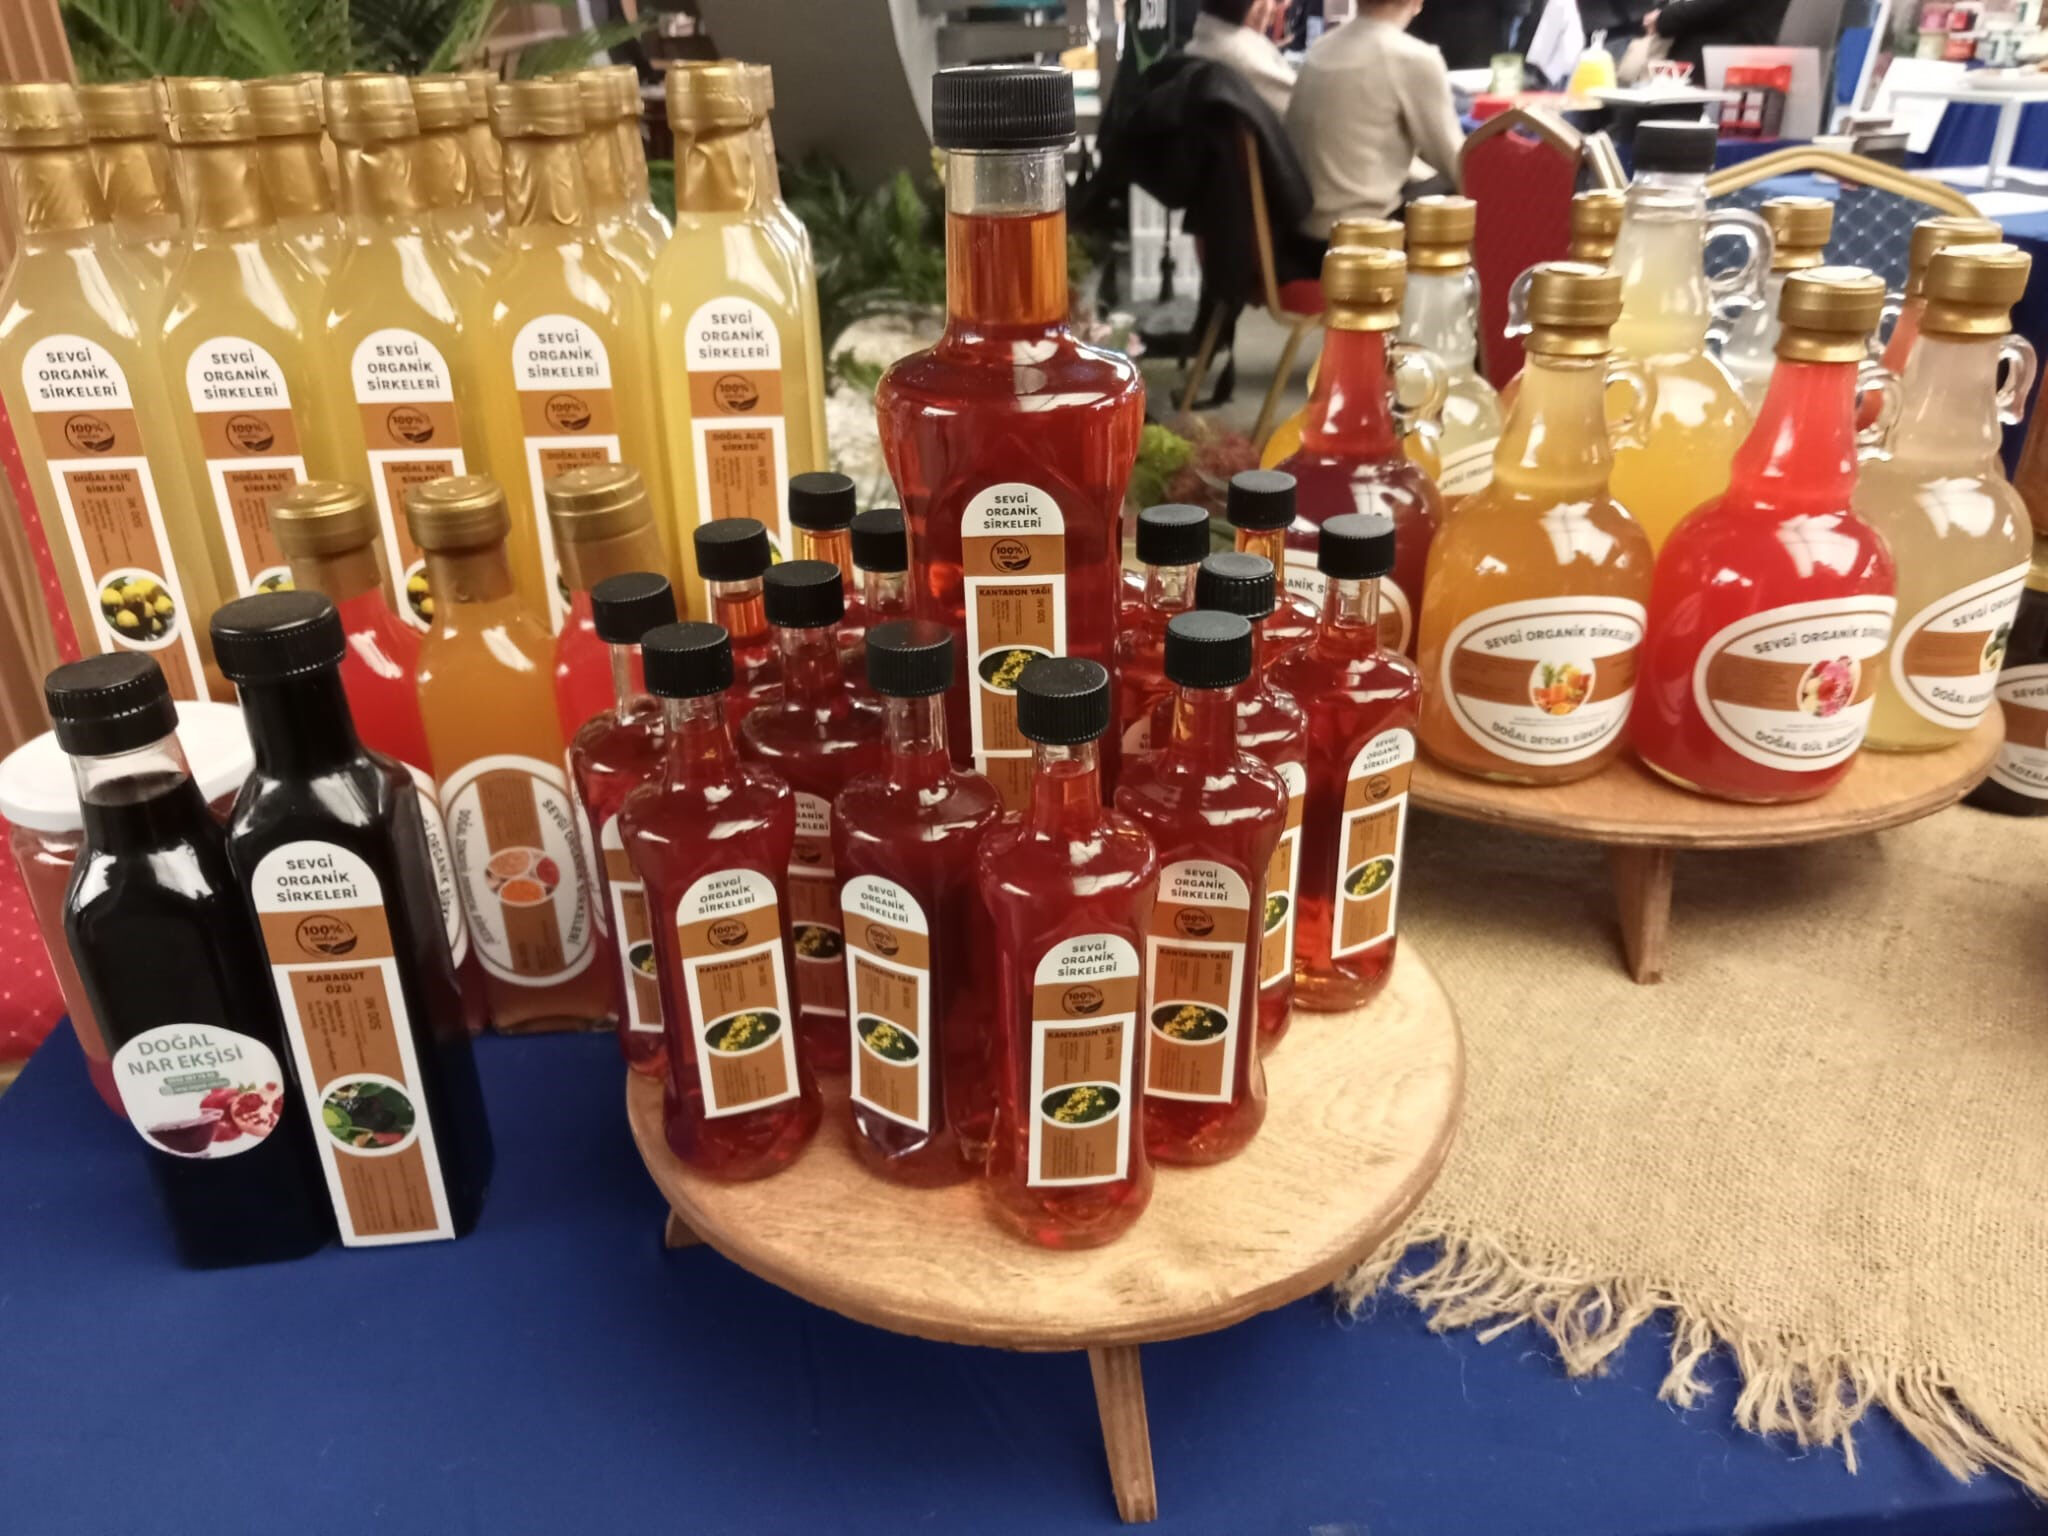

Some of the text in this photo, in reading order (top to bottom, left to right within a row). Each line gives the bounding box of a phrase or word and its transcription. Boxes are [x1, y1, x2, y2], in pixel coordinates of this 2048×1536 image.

[712, 310, 752, 325] SEVGİ
[538, 329, 580, 344] SEVGİ
[701, 327, 764, 342] ORGANİK
[46, 347, 92, 363] SEVGİ
[211, 348, 255, 365] SEVGİ
[376, 341, 419, 357] SEVGİ
[529, 345, 594, 361] ORGANİK
[699, 343, 770, 359] SİRKELERİ
[39, 365, 109, 381] ORGANİK
[204, 366, 270, 382] ORGANİK
[367, 358, 434, 374] ORGANİK
[528, 362, 599, 378] SİRKELERİ
[40, 382, 118, 399] SİRKELERİ
[204, 382, 279, 399] SİRKELERİ
[367, 375, 440, 391] SİRKELERİ
[719, 383, 749, 393] 100%
[551, 403, 581, 412] 100%
[70, 423, 104, 433] 100%
[231, 423, 264, 433] 100%
[392, 415, 423, 425] 100%
[994, 492, 1028, 504] SEVGİ
[985, 504, 1038, 516] ORGANİK
[983, 517, 1042, 529] SİRKELERİ
[996, 546, 1023, 555] 100%
[1284, 577, 1314, 592] ANİK
[1484, 632, 1523, 650] SEVGİ
[1526, 625, 1585, 642] ORGANİK
[1753, 633, 1797, 654] SEVGİ
[1800, 626, 1858, 644] ORGANİK
[1491, 721, 1528, 744] DOĞAL
[1376, 735, 1398, 748] SEVGİ
[1755, 731, 1797, 751] DOĞAL
[1366, 744, 1400, 760] ORGANİK
[1363, 754, 1400, 771] SİRKELERİ
[800, 800, 816, 810] VGİ
[286, 854, 333, 870] SEVGİ
[277, 870, 351, 887] ORGANİK
[1185, 868, 1218, 879] SEVGİ
[708, 875, 742, 891] SEVGİ
[867, 884, 897, 898] SEVGİ
[1174, 878, 1226, 890] ORGANİK
[277, 885, 358, 903] SİRKELERİ
[700, 885, 751, 903] ORGANİK
[861, 892, 905, 911] ORGANİK
[1171, 889, 1228, 901] SİRKELERİ
[699, 894, 755, 914] SİRKELERİ
[860, 902, 909, 924] SİRKELERİ
[302, 924, 344, 936] 100%
[713, 924, 740, 935] 100%
[1072, 941, 1107, 953] SEVGİ
[1061, 951, 1114, 965] ORGANİK
[307, 971, 365, 983] KARADUT
[1058, 962, 1117, 976] SİRKELERİ
[325, 983, 352, 995] ÖZÜ
[1069, 992, 1096, 1001] 100%
[137, 1033, 216, 1056] DOĞAL
[128, 1043, 244, 1076] NAR EKŞİSİ
